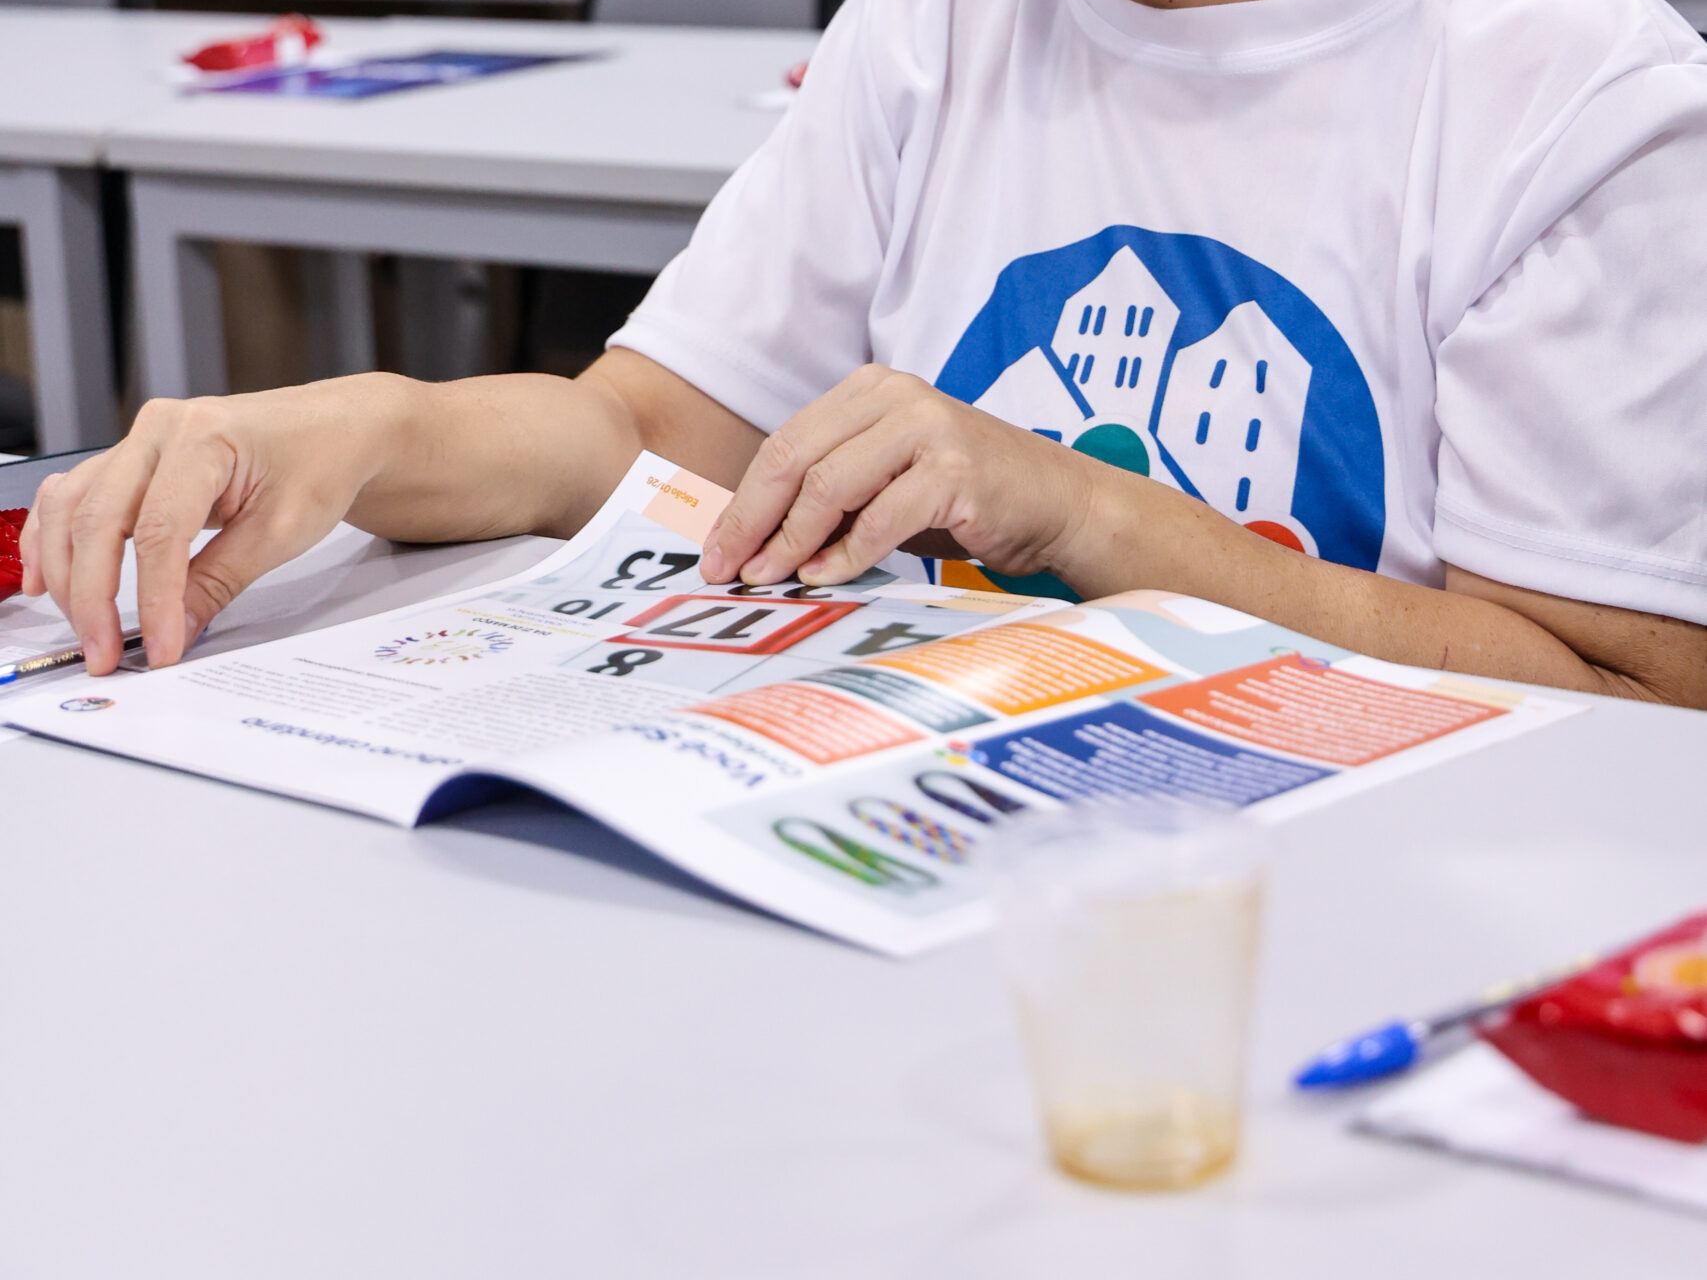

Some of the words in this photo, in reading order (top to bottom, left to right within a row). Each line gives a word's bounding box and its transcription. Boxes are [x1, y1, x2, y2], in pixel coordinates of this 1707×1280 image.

[671, 488, 700, 508] Edição
[600, 550, 701, 591] 23
[646, 606, 777, 640] 17
[586, 649, 664, 677] 8
